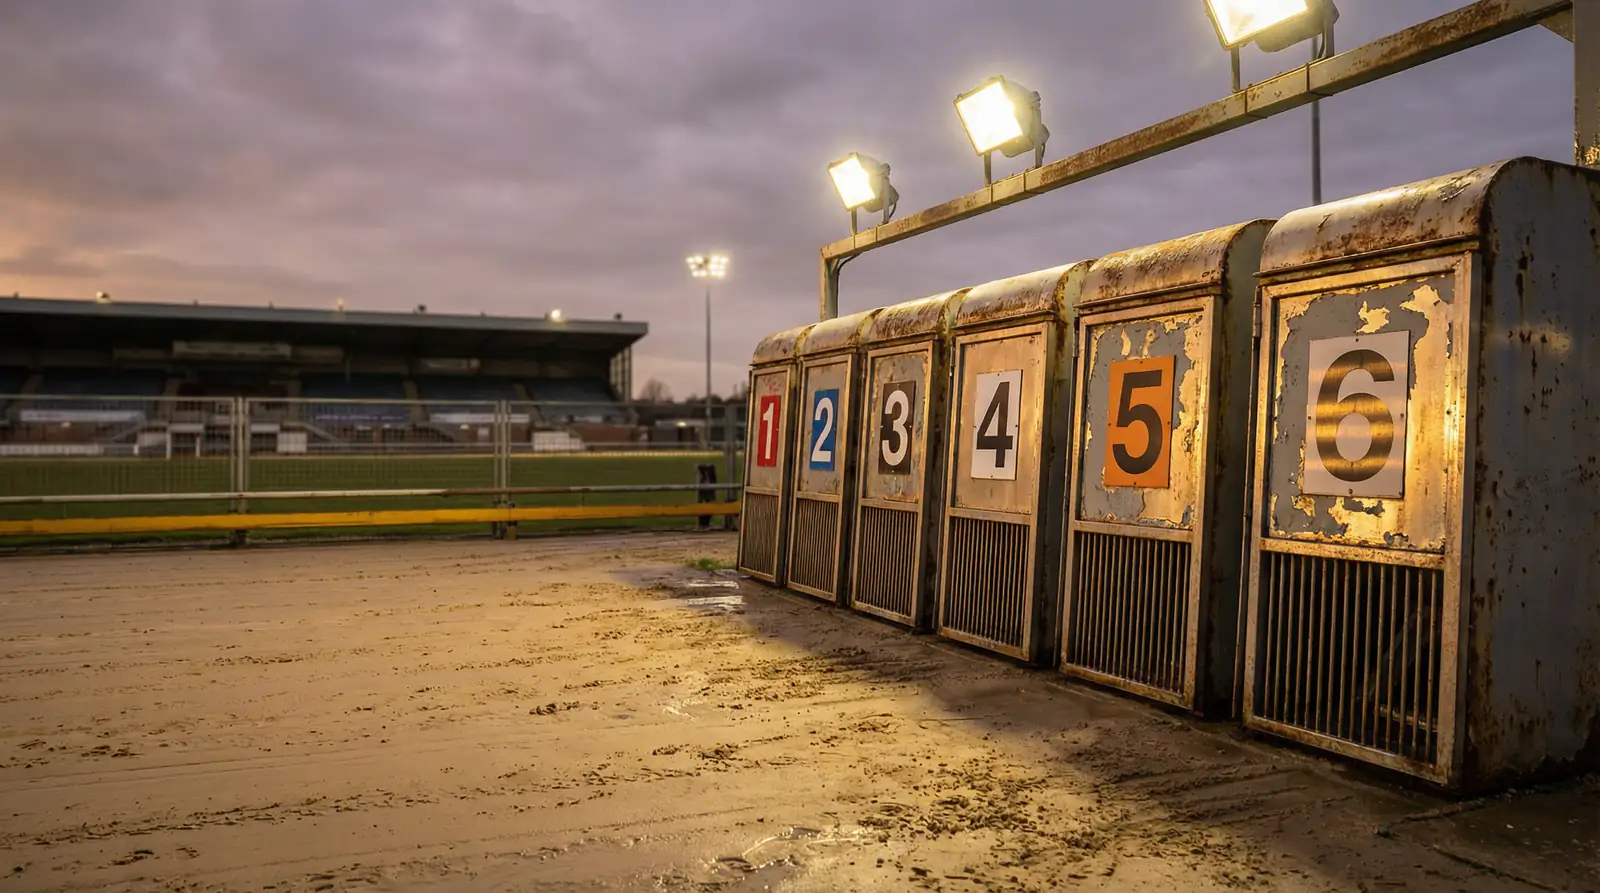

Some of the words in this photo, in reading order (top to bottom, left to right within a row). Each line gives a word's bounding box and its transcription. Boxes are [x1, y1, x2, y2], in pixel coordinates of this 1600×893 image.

[763, 402, 774, 459] 1
[811, 397, 834, 462] 2
[882, 390, 909, 466] 3
[976, 381, 1014, 468] 4
[1112, 370, 1163, 475] 5
[1315, 349, 1395, 482] 6
